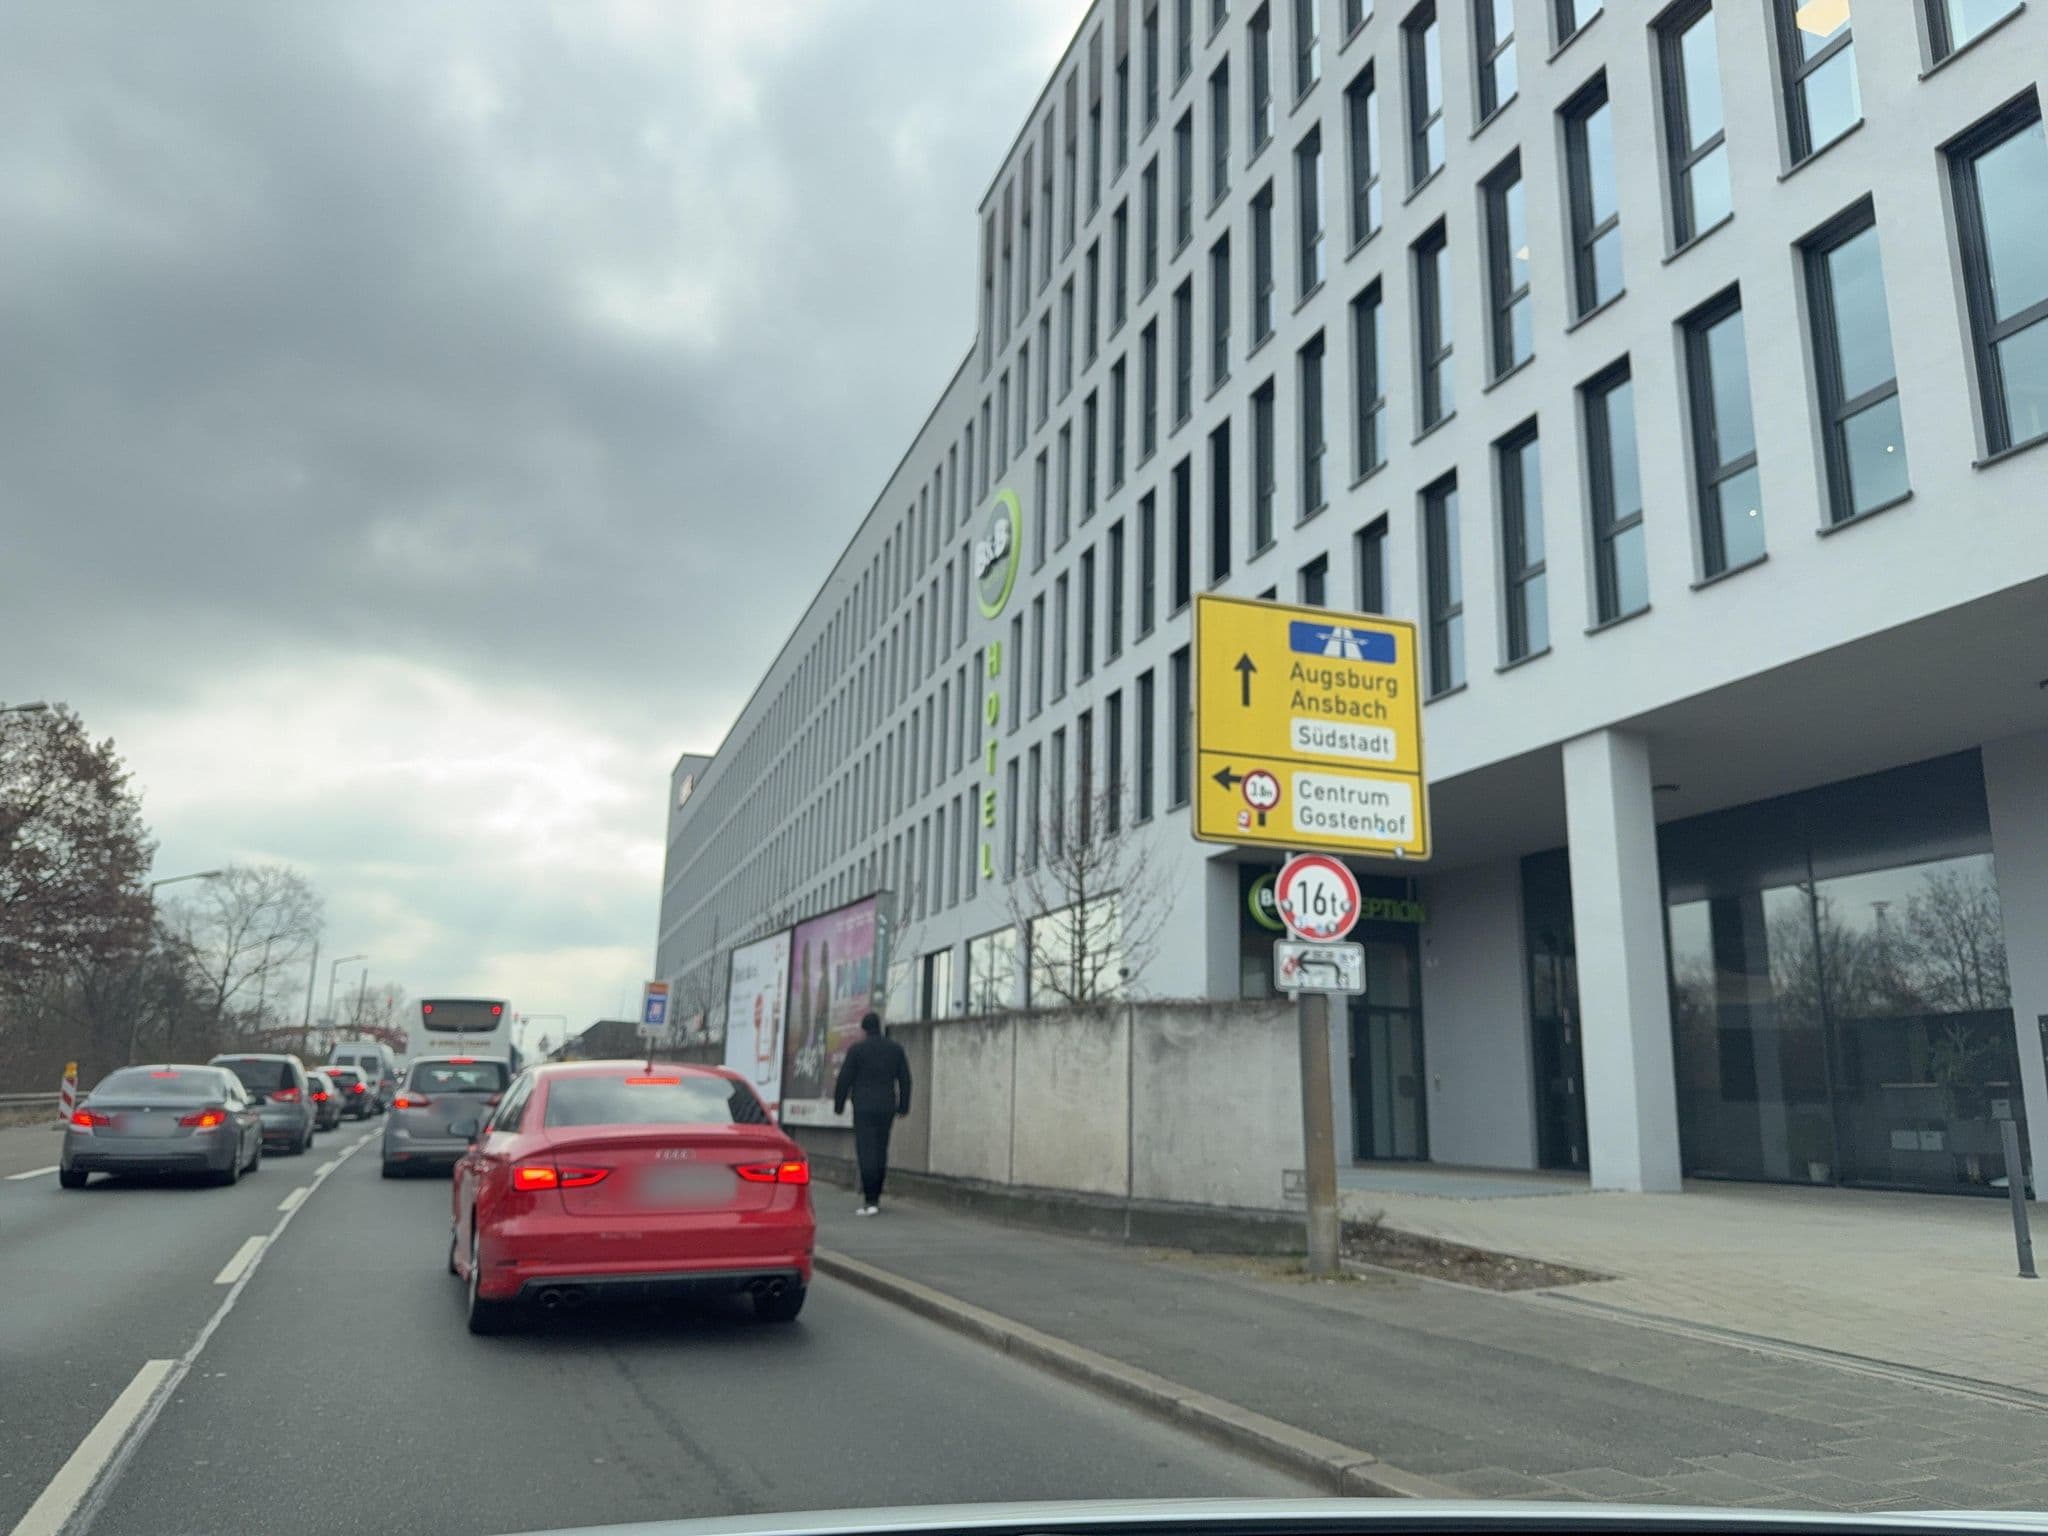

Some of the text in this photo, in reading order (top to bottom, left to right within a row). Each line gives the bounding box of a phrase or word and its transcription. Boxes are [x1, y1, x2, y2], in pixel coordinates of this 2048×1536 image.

[1290, 662, 1398, 699] Augsburg
[1290, 691, 1388, 720] Ansbach
[1298, 725, 1390, 755] Südstadt
[982, 640, 1002, 880] HOTEL
[1299, 779, 1389, 807] Centrum
[1299, 806, 1407, 835] Gostenhof
[1358, 896, 1426, 922] EPTION
